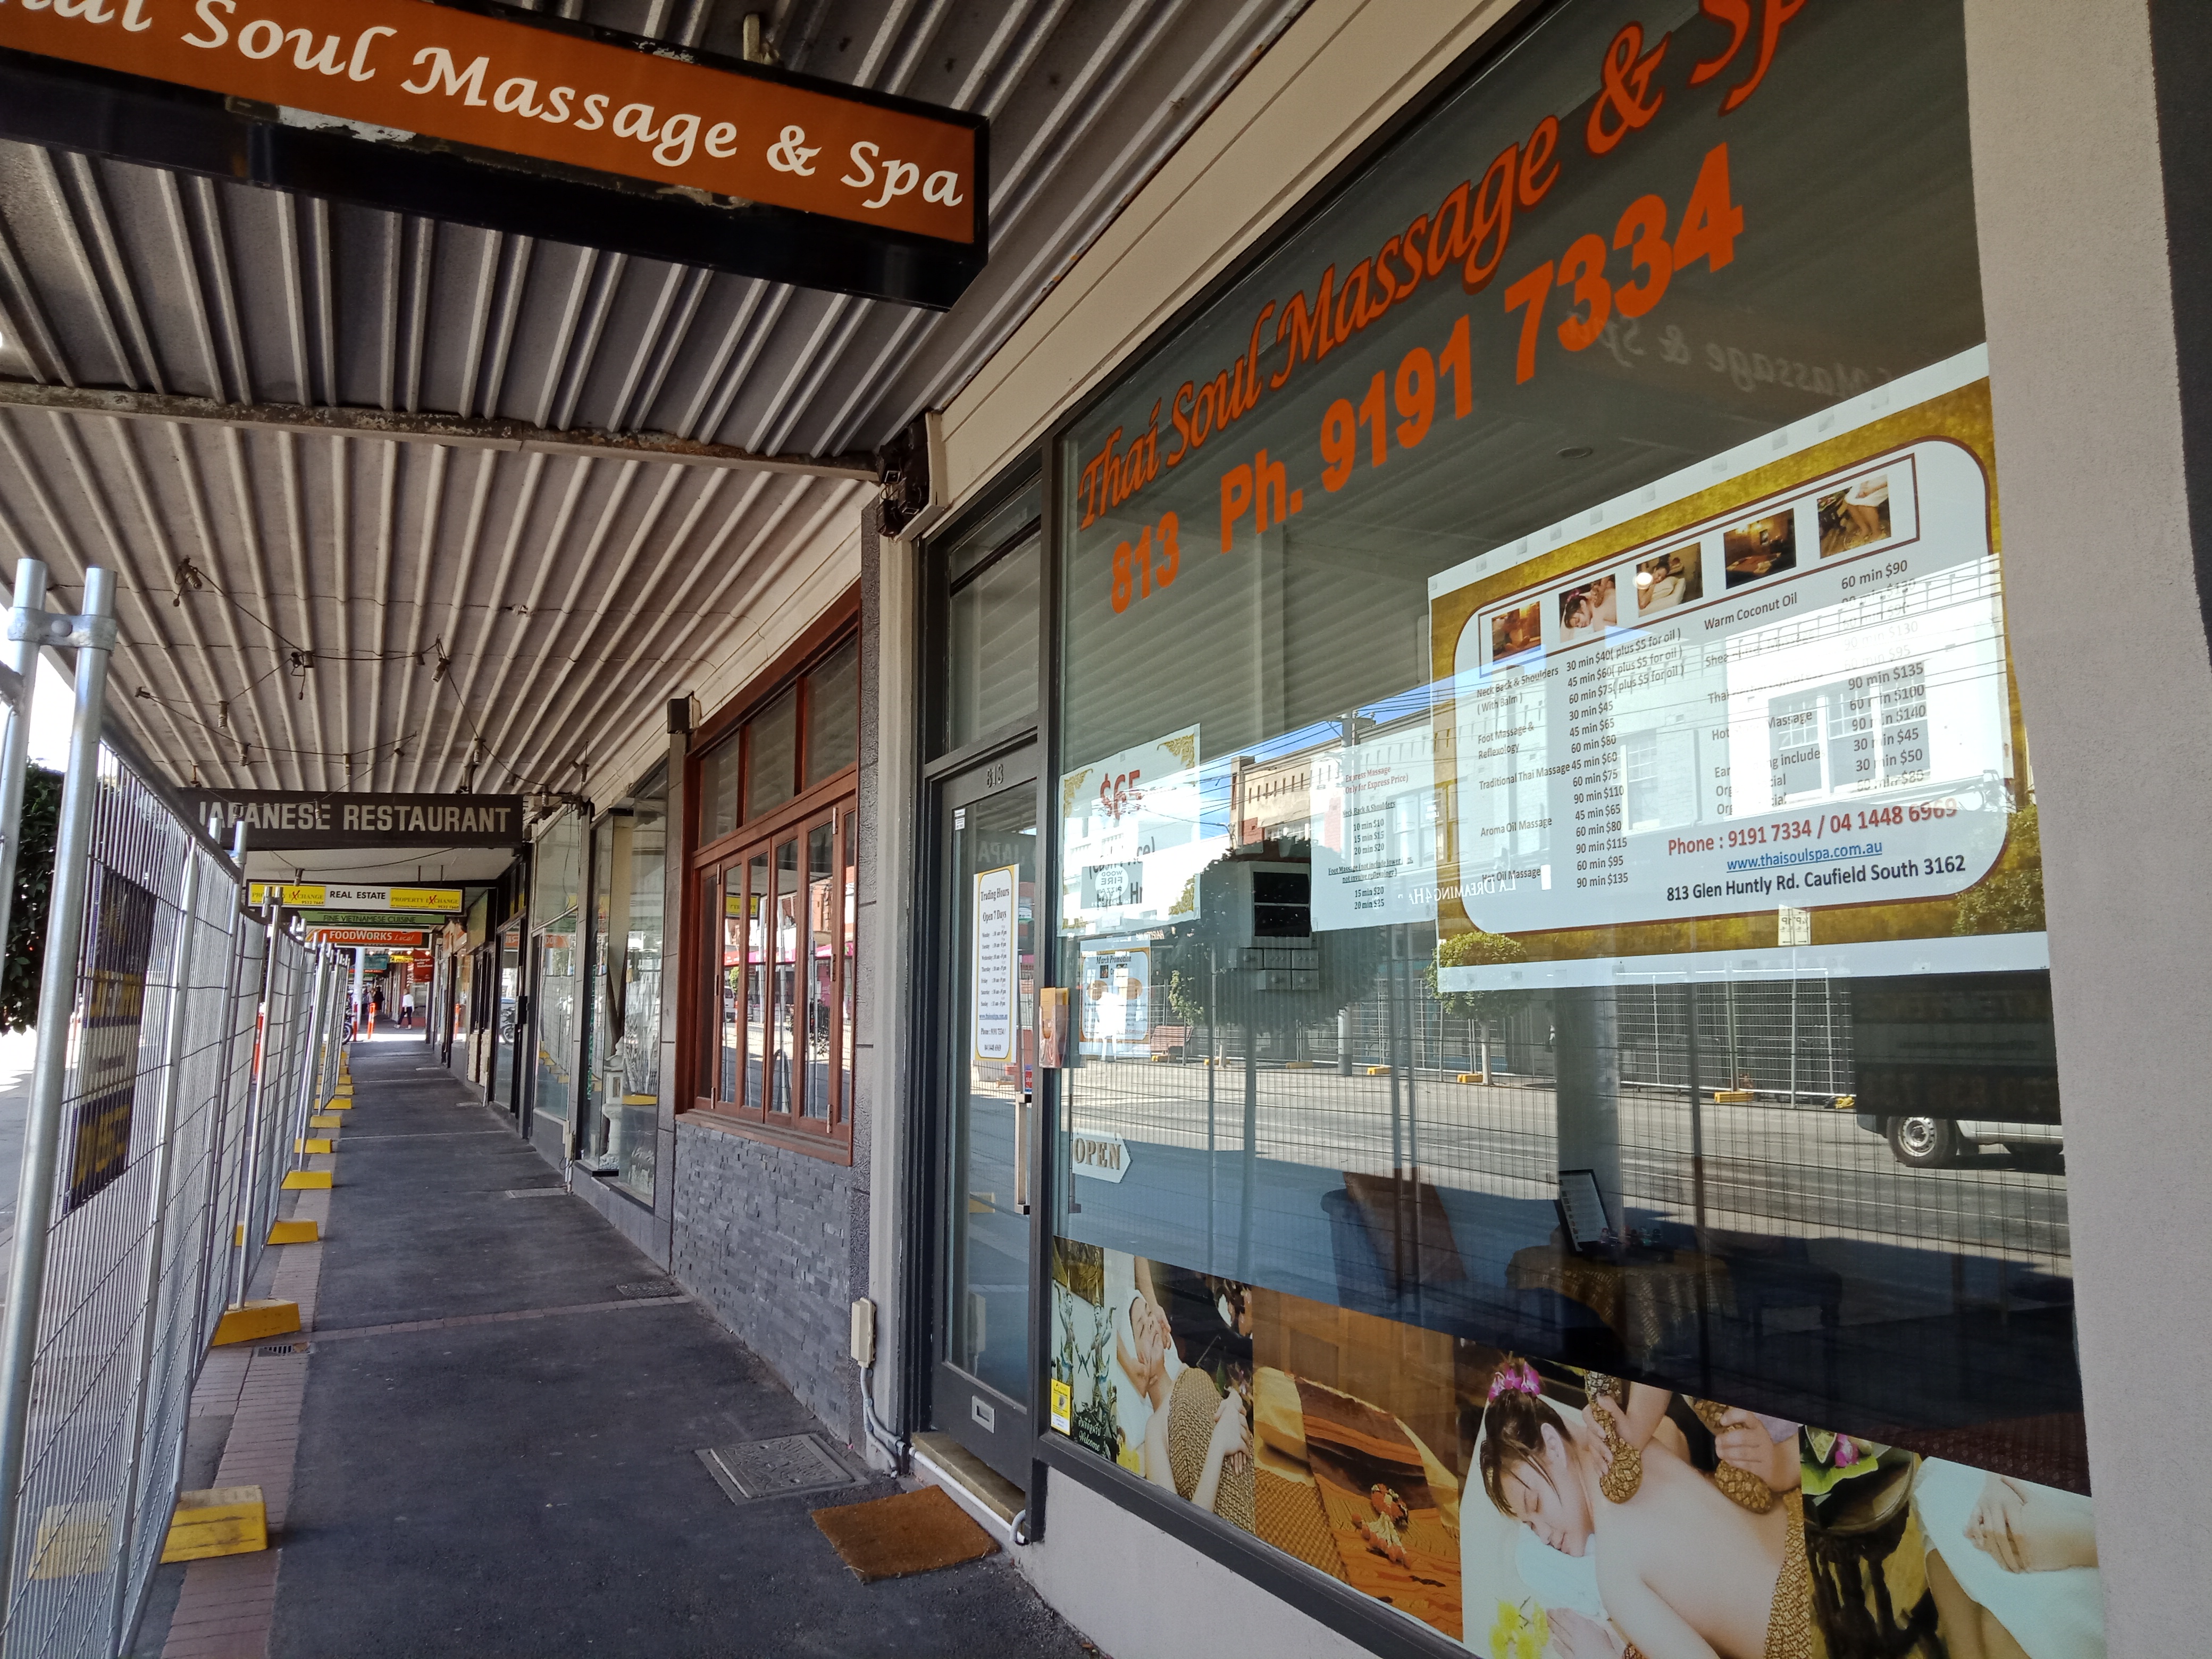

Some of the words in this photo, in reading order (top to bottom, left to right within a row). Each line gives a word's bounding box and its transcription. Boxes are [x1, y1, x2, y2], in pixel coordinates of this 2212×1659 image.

[180, 0, 398, 82] Soul
[400, 46, 738, 167] Massage
[766, 125, 822, 177] &
[840, 140, 964, 210] Spa
[1078, 397, 1161, 531] Thai
[1166, 299, 1276, 468] Soul
[1269, 114, 1562, 391] Massage
[1584, 20, 1672, 159] &
[1111, 511, 1180, 614] 813
[1221, 448, 1303, 555] Ph.
[1320, 313, 1472, 492] 9191
[1504, 142, 1745, 385] 7334
[1841, 576, 1855, 589] 60
[1859, 569, 1882, 584] min
[1886, 560, 1907, 578] $90
[1704, 615, 1734, 630] Warm
[1737, 599, 1780, 620] Coconut
[1782, 592, 1798, 607] Oil
[1566, 660, 1576, 672] 30
[1578, 655, 1594, 668] min
[1616, 646, 1633, 659] plus
[1636, 639, 1646, 651] $5
[1648, 636, 1662, 647] for
[1664, 630, 1675, 642] oil
[1521, 667, 1559, 685] Shoulders
[1568, 677, 1577, 688] 45
[1580, 672, 1595, 685] min
[1618, 661, 1635, 675] plus
[1637, 656, 1647, 669] $5
[1650, 652, 1663, 664] for
[1665, 648, 1677, 660] oil
[1848, 677, 1863, 690] 90
[1867, 671, 1890, 686] min
[1893, 663, 1923, 681] $135
[1569, 693, 1578, 705] 60
[1581, 689, 1596, 701] min
[1619, 679, 1636, 693] plus
[1651, 669, 1664, 682] for
[1667, 666, 1678, 677] oil
[1482, 700, 1498, 712] With
[1501, 695, 1518, 707] Balm
[1569, 710, 1579, 721] 30
[1581, 706, 1597, 718] min
[1598, 701, 1613, 715] $45
[1570, 727, 1579, 737] 45
[1582, 723, 1597, 735] min
[1599, 718, 1614, 732] $65
[1852, 718, 1866, 731] 90
[1478, 732, 1493, 744] Foot
[1495, 725, 1526, 740] Massage
[1571, 743, 1581, 753] 60
[1583, 740, 1599, 751] min
[1601, 734, 1616, 748] $80
[1854, 739, 1867, 751] 30
[1897, 728, 1918, 744] $45
[1479, 743, 1519, 760] Reflexology
[1572, 759, 1581, 770] 45
[1584, 756, 1599, 768] min
[1602, 751, 1618, 765] $60
[1856, 759, 1870, 772] 30
[1900, 749, 1923, 766] $50
[986, 764, 1004, 787] 813
[1346, 772, 1365, 783] Express
[1367, 767, 1391, 777] Massage
[1368, 780, 1389, 790] Express
[1391, 773, 1408, 784] Price)
[1479, 774, 1516, 790] Traditional
[1518, 770, 1534, 782] Thai
[1536, 764, 1570, 778] Massage
[1573, 776, 1582, 787] 60
[1585, 773, 1601, 785] min
[1603, 768, 1618, 783] $75
[1574, 793, 1583, 804] 90
[1586, 790, 1602, 801] min
[1604, 785, 1624, 800] $110
[1371, 801, 1395, 811] Shoulders
[1575, 810, 1585, 820] 45
[1588, 807, 1604, 819] min
[1605, 804, 1621, 817] $65
[343, 805, 511, 833] RESTAURANT
[1361, 820, 1372, 828] min
[1480, 826, 1505, 837] Aroma
[1506, 822, 1516, 832] Oil
[1519, 818, 1552, 831] Massage
[1668, 837, 1714, 856] Phone
[1728, 826, 1766, 848] 9191
[1771, 819, 1812, 841] 7334
[1830, 813, 1851, 833] 04
[1858, 806, 1903, 830] 1448
[1909, 798, 1957, 822] 6969
[1362, 833, 1372, 842] min
[1576, 827, 1586, 837] 60
[1588, 824, 1604, 835] min
[1606, 821, 1622, 834] $80
[1362, 845, 1373, 853] min
[1576, 843, 1586, 854] 90
[1588, 841, 1604, 852] min
[1606, 837, 1627, 851] $115
[1577, 860, 1587, 870] 60
[1589, 858, 1606, 869] min
[1608, 856, 1623, 868] $95
[1727, 842, 1882, 873] www.thaisoulspa.com.au
[1496, 871, 1506, 881] Oil
[1508, 867, 1541, 880] Massage
[1577, 877, 1587, 888] 90
[1589, 876, 1606, 886] min
[1607, 873, 1628, 886] $135
[1667, 885, 1688, 901] 813
[1692, 883, 1722, 899] Glen
[1726, 876, 1772, 895] Huntly
[1777, 873, 1799, 891] Rd.
[1804, 865, 1866, 887] Caufield
[1871, 859, 1918, 881] South
[1924, 854, 1965, 875] 3162
[289, 890, 324, 901] EXCHANGE
[426, 894, 459, 904] EXCHANGE
[981, 890, 996, 901] Trading
[997, 888, 1010, 898] Hours
[1362, 888, 1372, 896] min
[1373, 886, 1384, 895] $20
[983, 912, 993, 923] Open
[994, 910, 996, 920] 7
[997, 910, 1007, 921] Days
[330, 930, 392, 941] FOODWORKS
[1073, 1138, 1121, 1170] OPEN
[1079, 1430, 1100, 1452] Welcome
